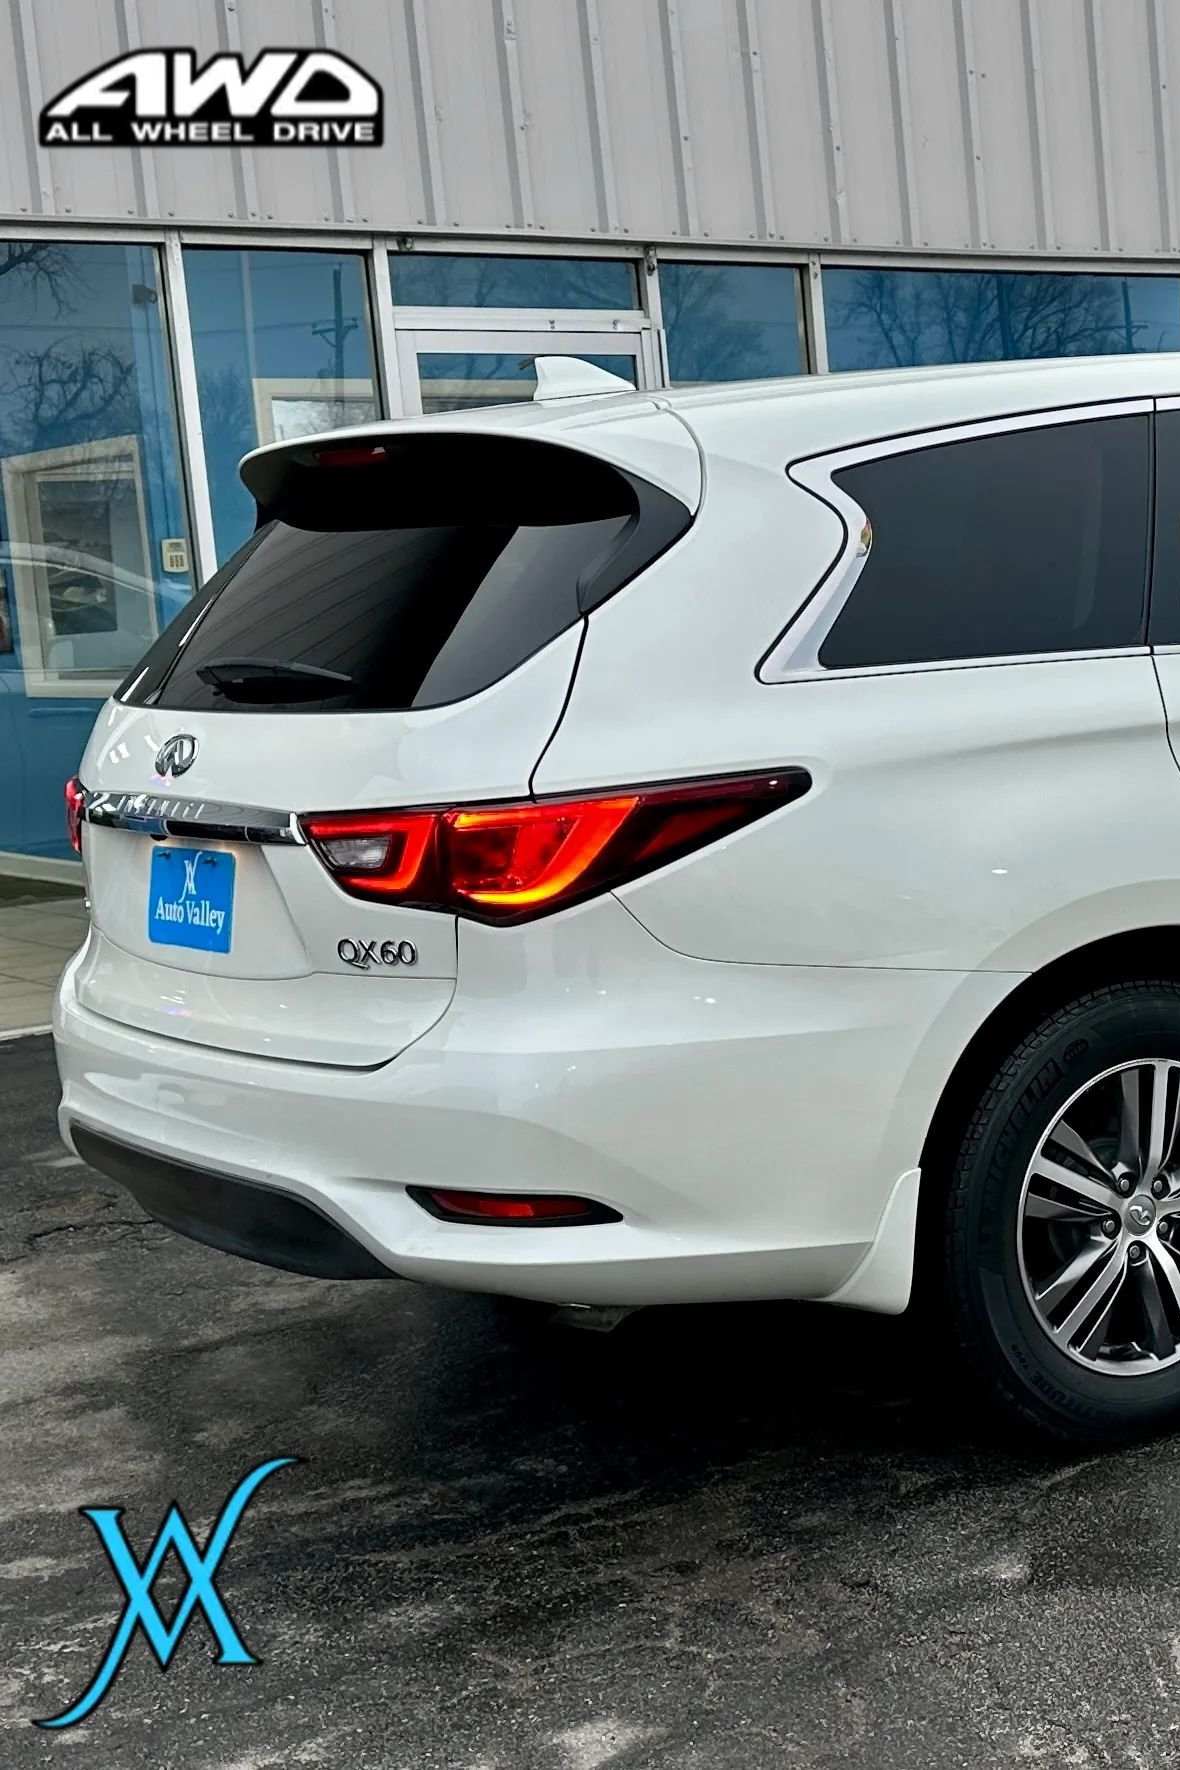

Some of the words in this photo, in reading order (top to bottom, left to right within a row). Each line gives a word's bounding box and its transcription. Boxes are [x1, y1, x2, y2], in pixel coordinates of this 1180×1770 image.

[155, 896, 184, 924] Auto
[186, 899, 226, 936] Valley
[337, 938, 418, 970] QX60
